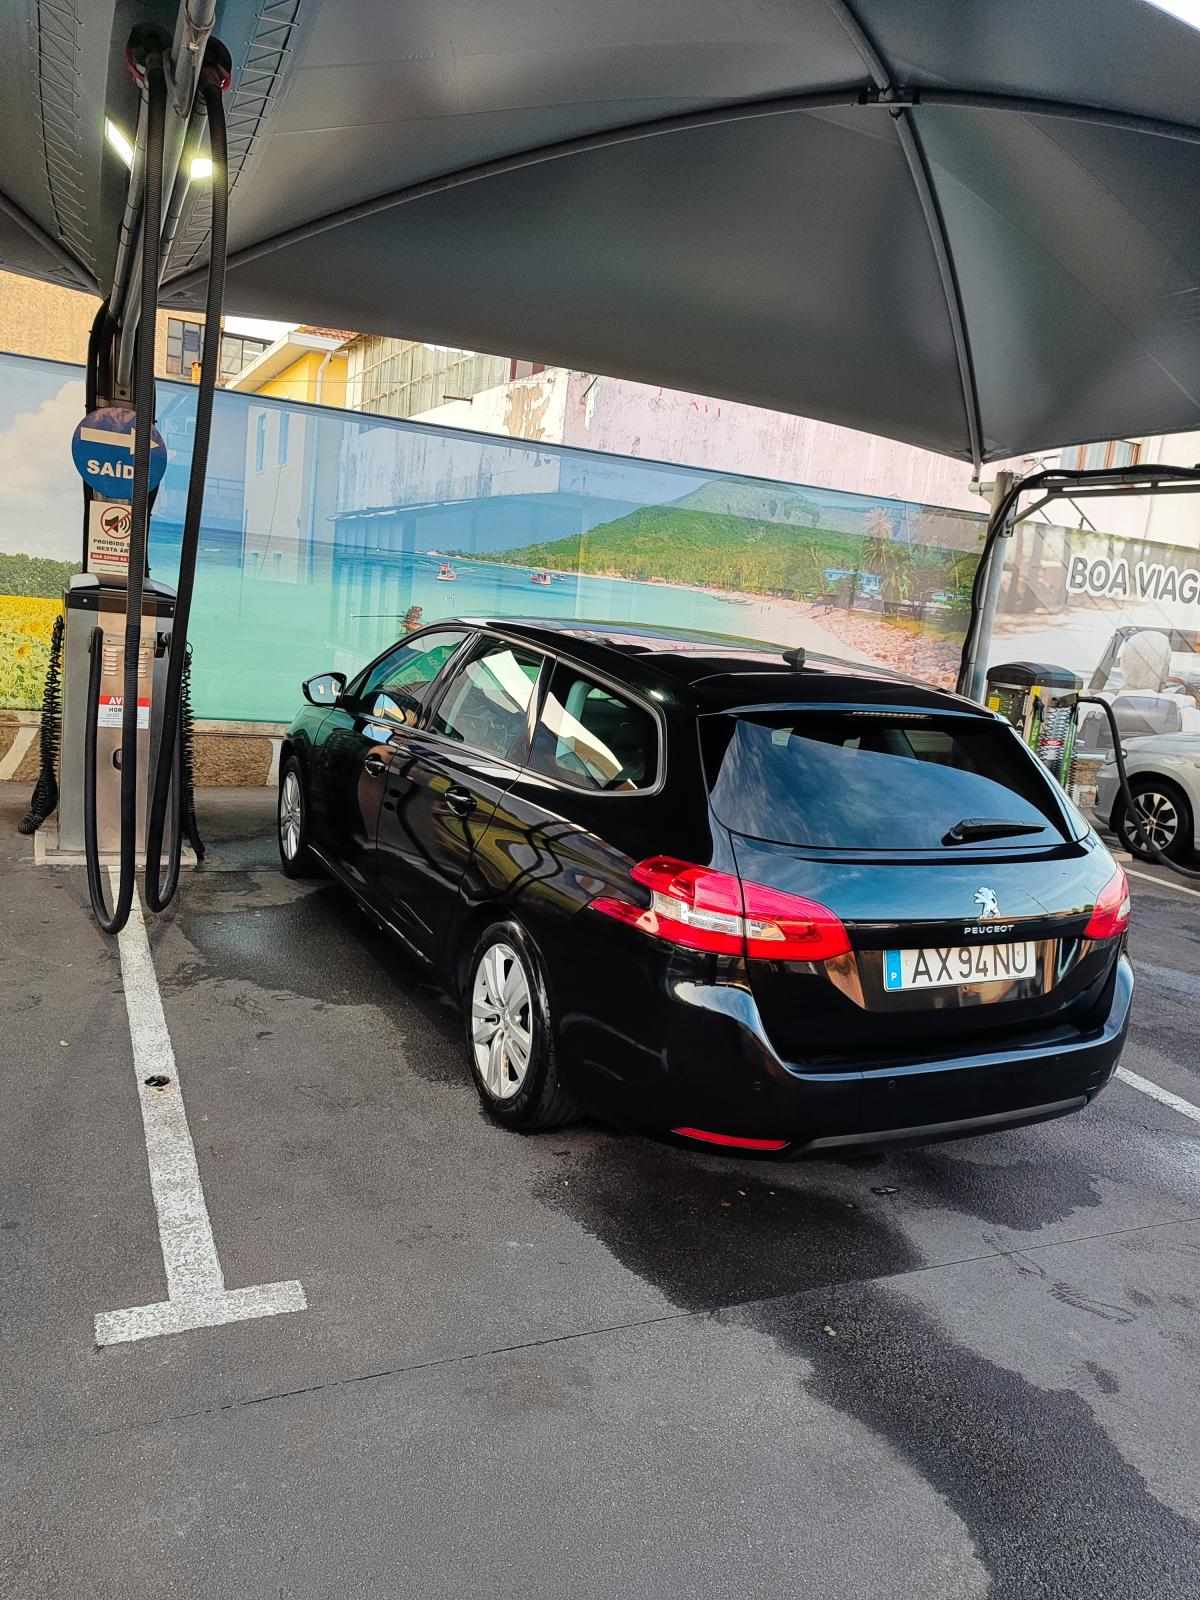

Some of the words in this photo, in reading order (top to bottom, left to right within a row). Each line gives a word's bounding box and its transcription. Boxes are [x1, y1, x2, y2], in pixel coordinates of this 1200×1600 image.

[87, 459, 134, 480] SAÍD
[1069, 556, 1128, 595] BOA
[1137, 565, 1200, 605] VIAG
[963, 924, 1015, 935] PEUGEOT
